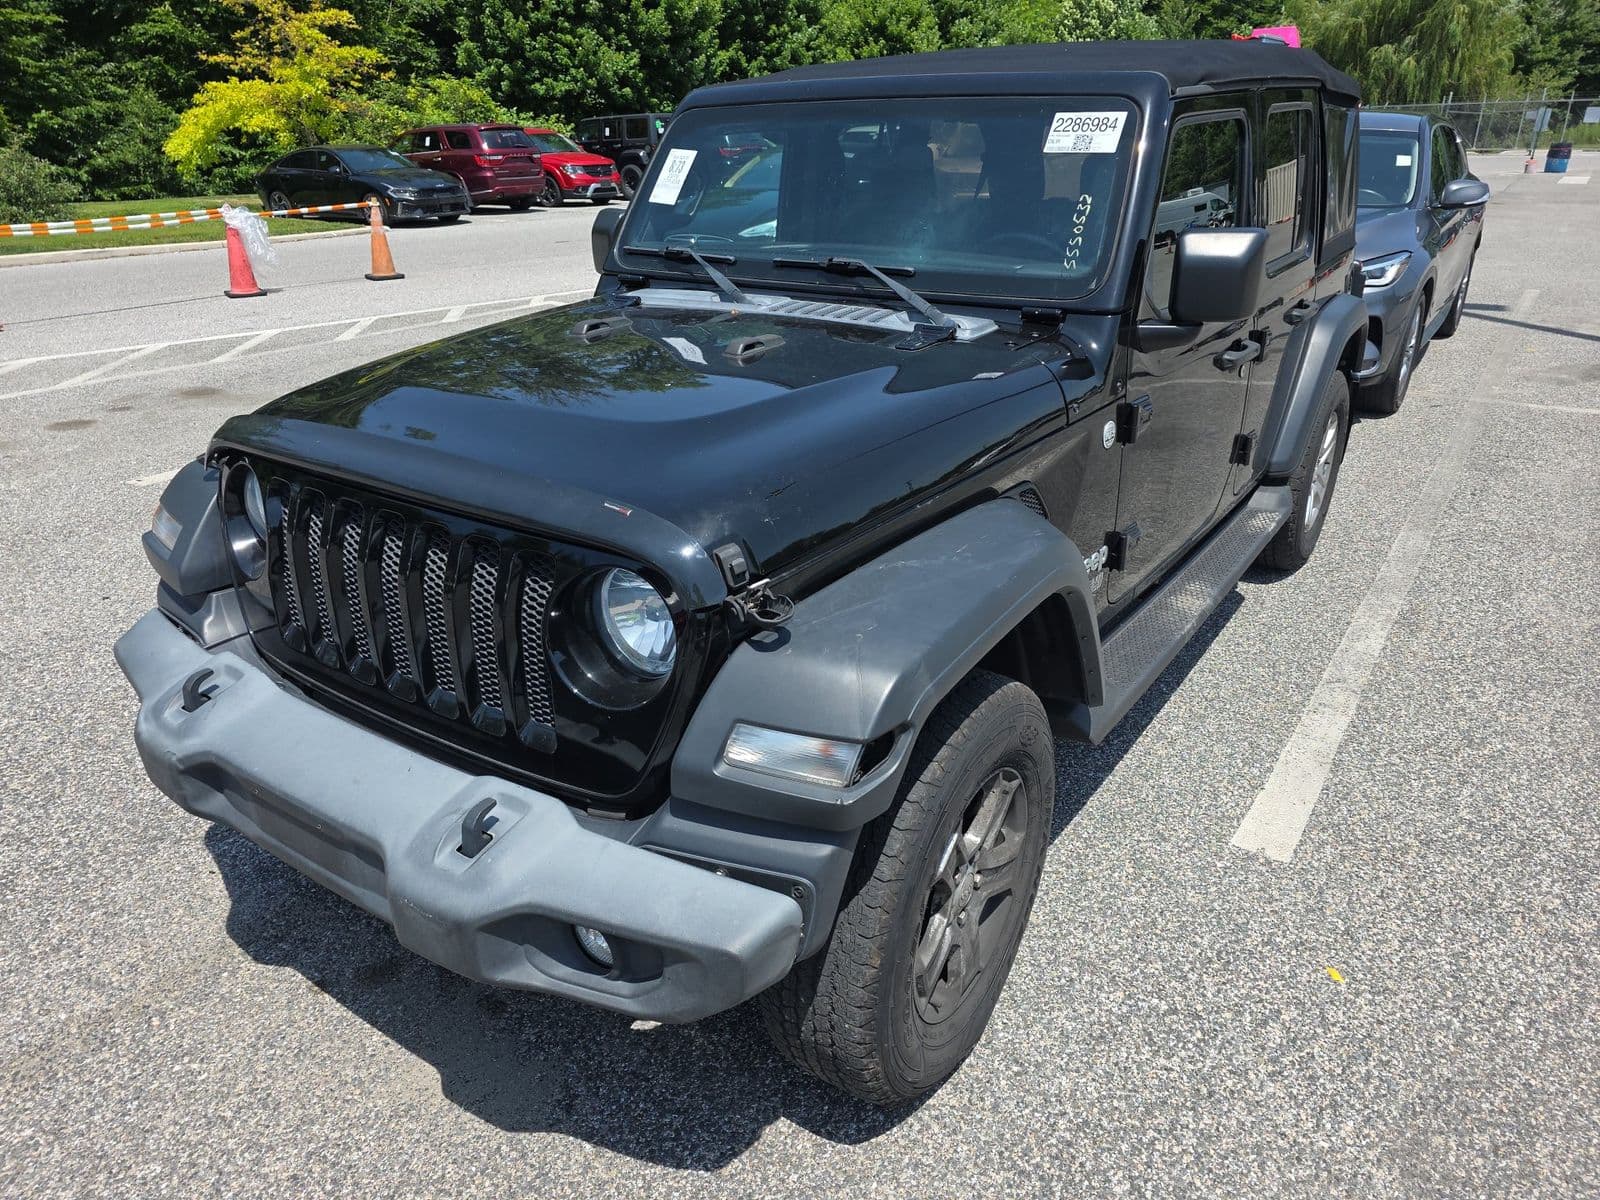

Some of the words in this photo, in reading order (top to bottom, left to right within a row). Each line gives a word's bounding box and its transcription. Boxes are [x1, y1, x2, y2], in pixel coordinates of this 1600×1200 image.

[1053, 116, 1119, 133] 2286984
[1064, 194, 1092, 269] 5550532
[1081, 545, 1109, 573] eep
